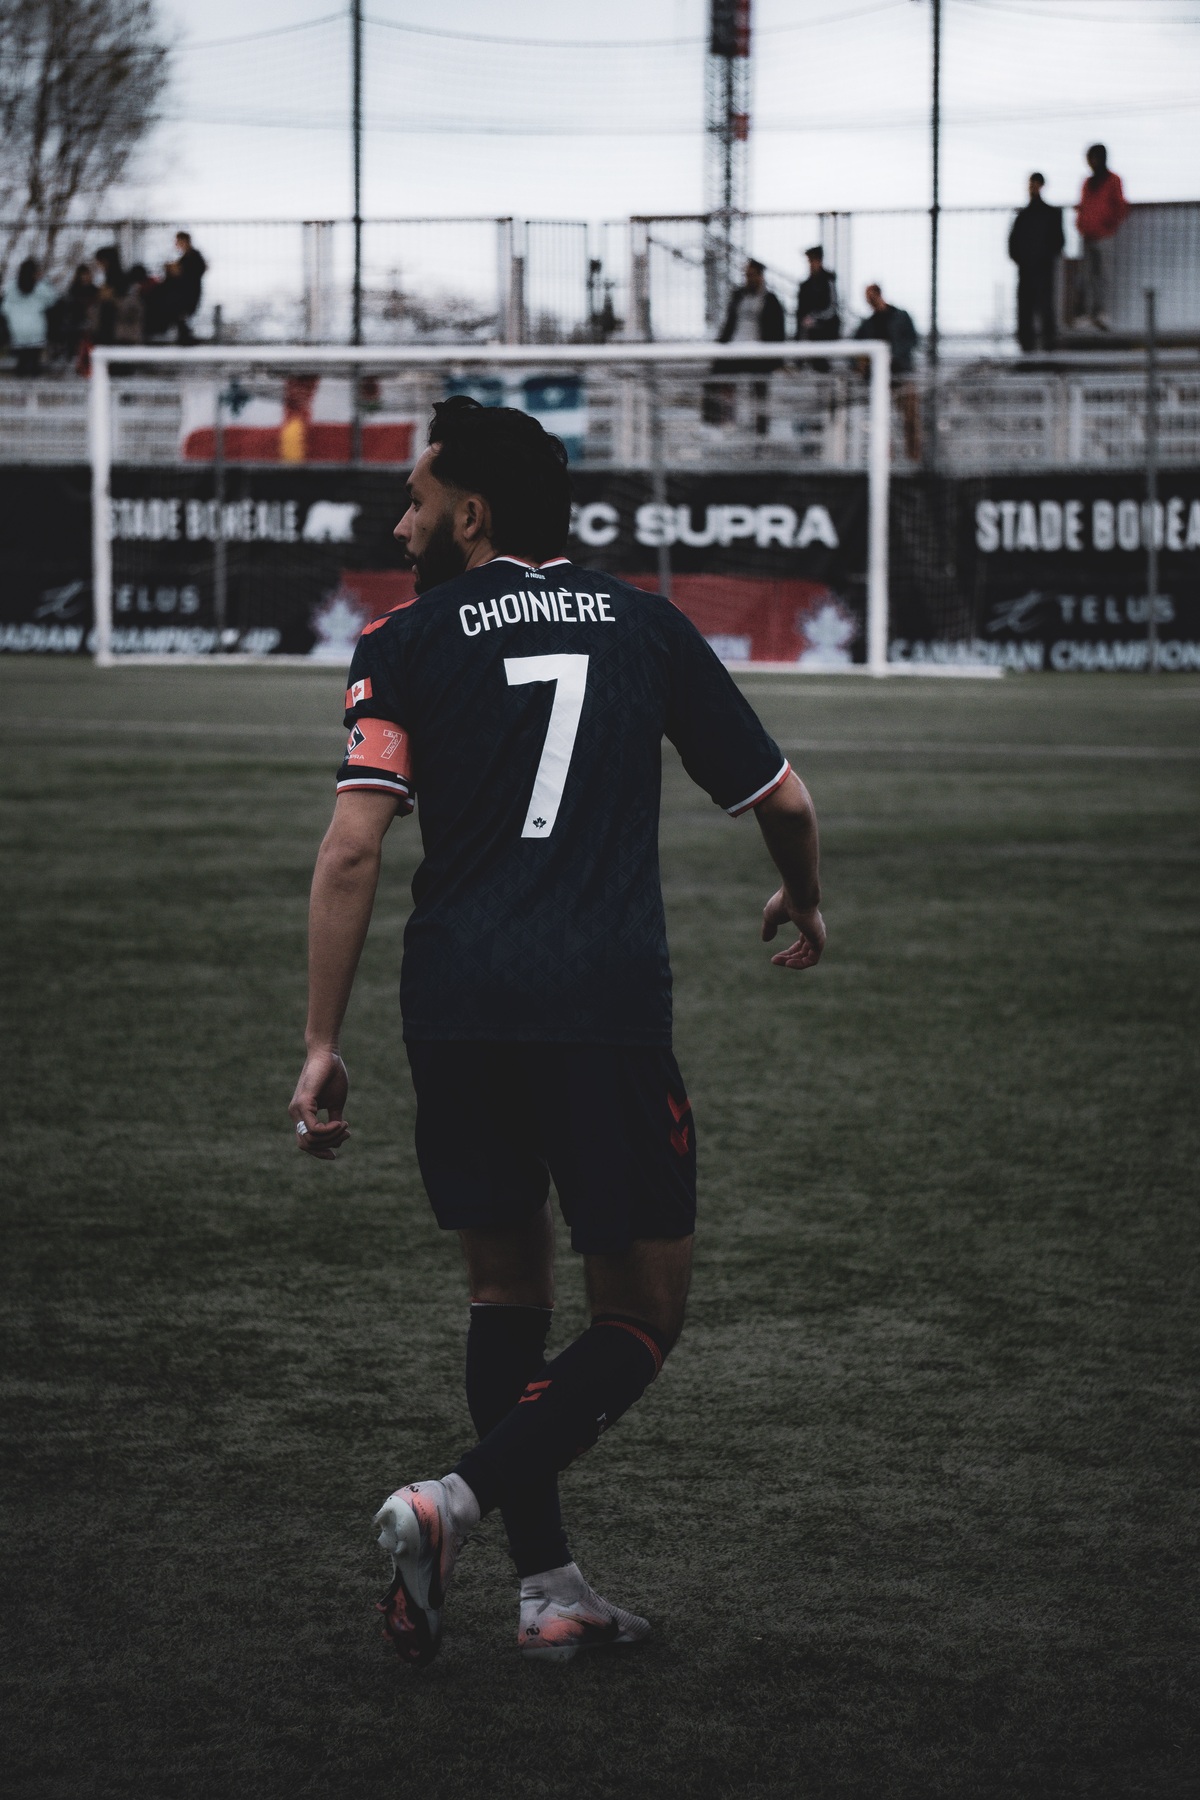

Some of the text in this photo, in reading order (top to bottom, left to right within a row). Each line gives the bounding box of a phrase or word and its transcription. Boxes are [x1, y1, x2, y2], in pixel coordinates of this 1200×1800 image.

[635, 503, 839, 548] SUPRA
[975, 499, 1084, 551] STADE
[115, 584, 200, 614] ELUS
[459, 587, 616, 637] CHOINIÈRE
[1057, 594, 1176, 624] TELUS
[503, 654, 589, 838] 7
